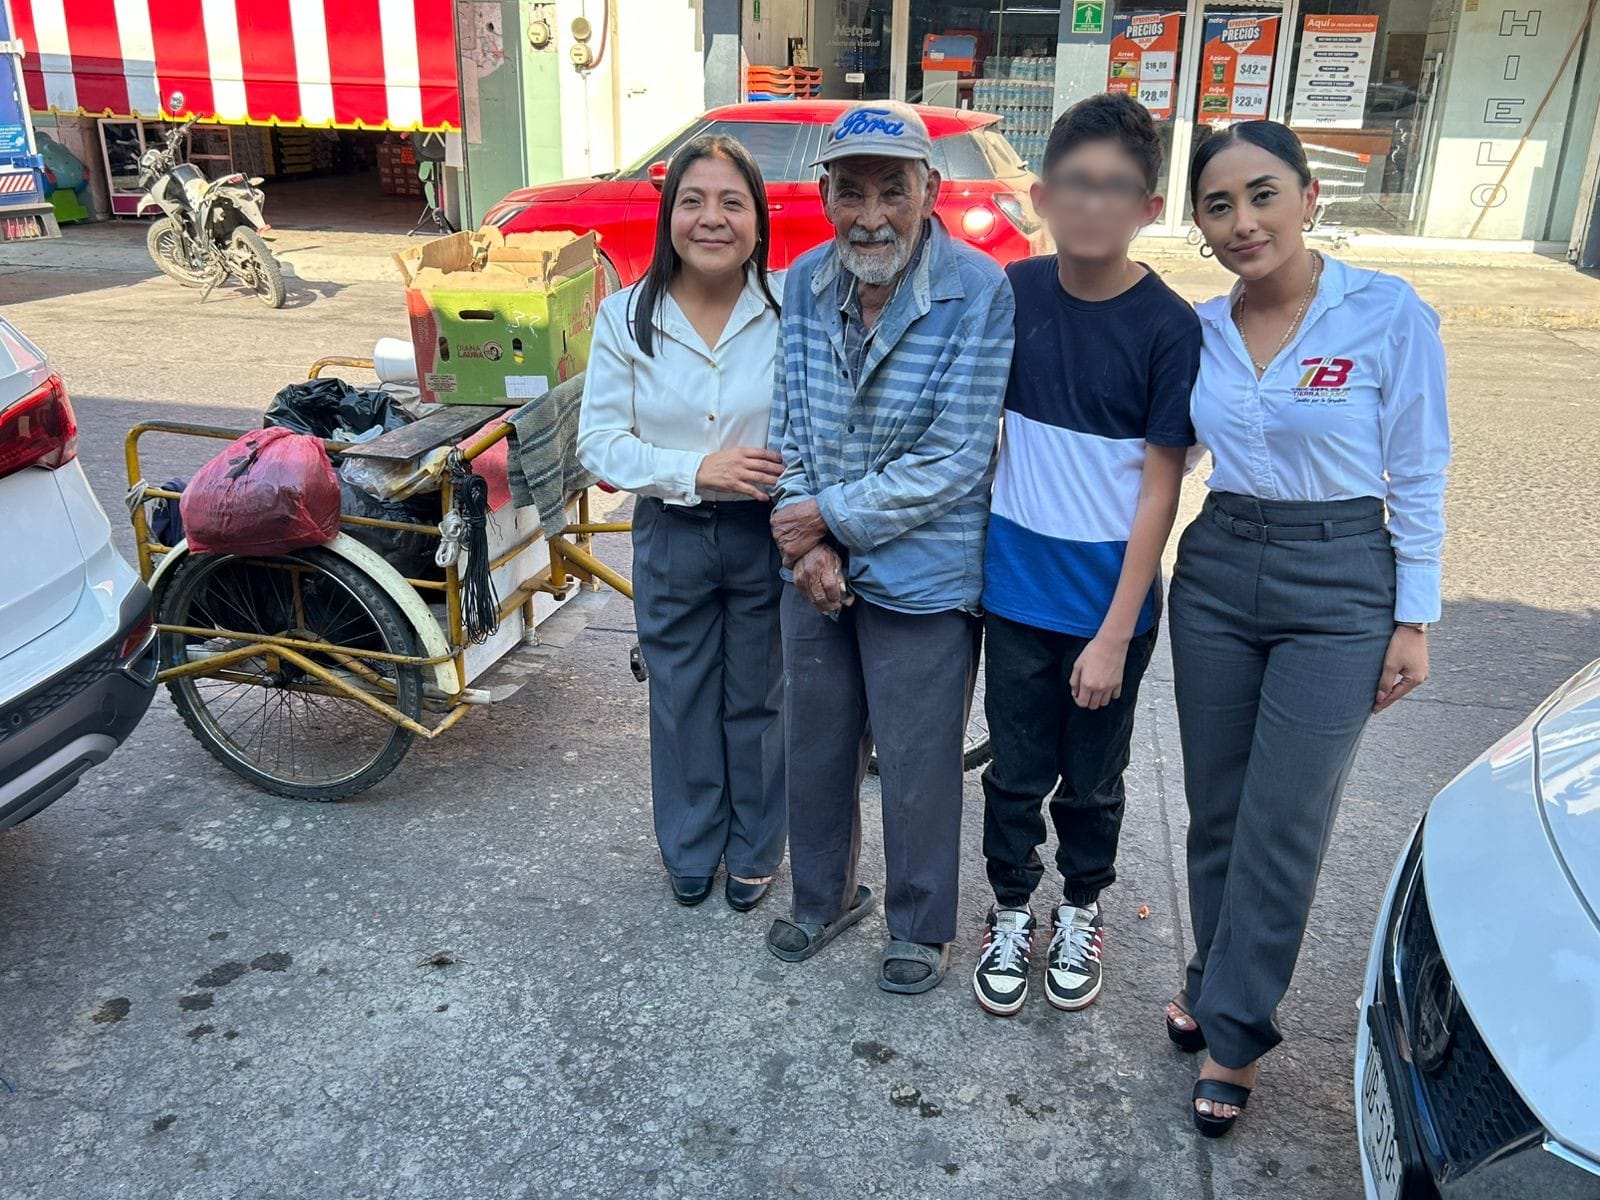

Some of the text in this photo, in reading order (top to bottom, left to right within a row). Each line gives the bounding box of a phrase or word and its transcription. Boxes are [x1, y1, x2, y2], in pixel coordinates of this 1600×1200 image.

[1307, 18, 1331, 29] Aquí
[833, 24, 864, 37] Neto
[1126, 23, 1163, 38] PRECIOS
[1222, 27, 1260, 41] PRECIOS
[1140, 90, 1168, 101] $28.00
[1235, 96, 1262, 107] $23.00
[1470, 10, 1542, 208] HIELO
[835, 109, 904, 140] Ford
